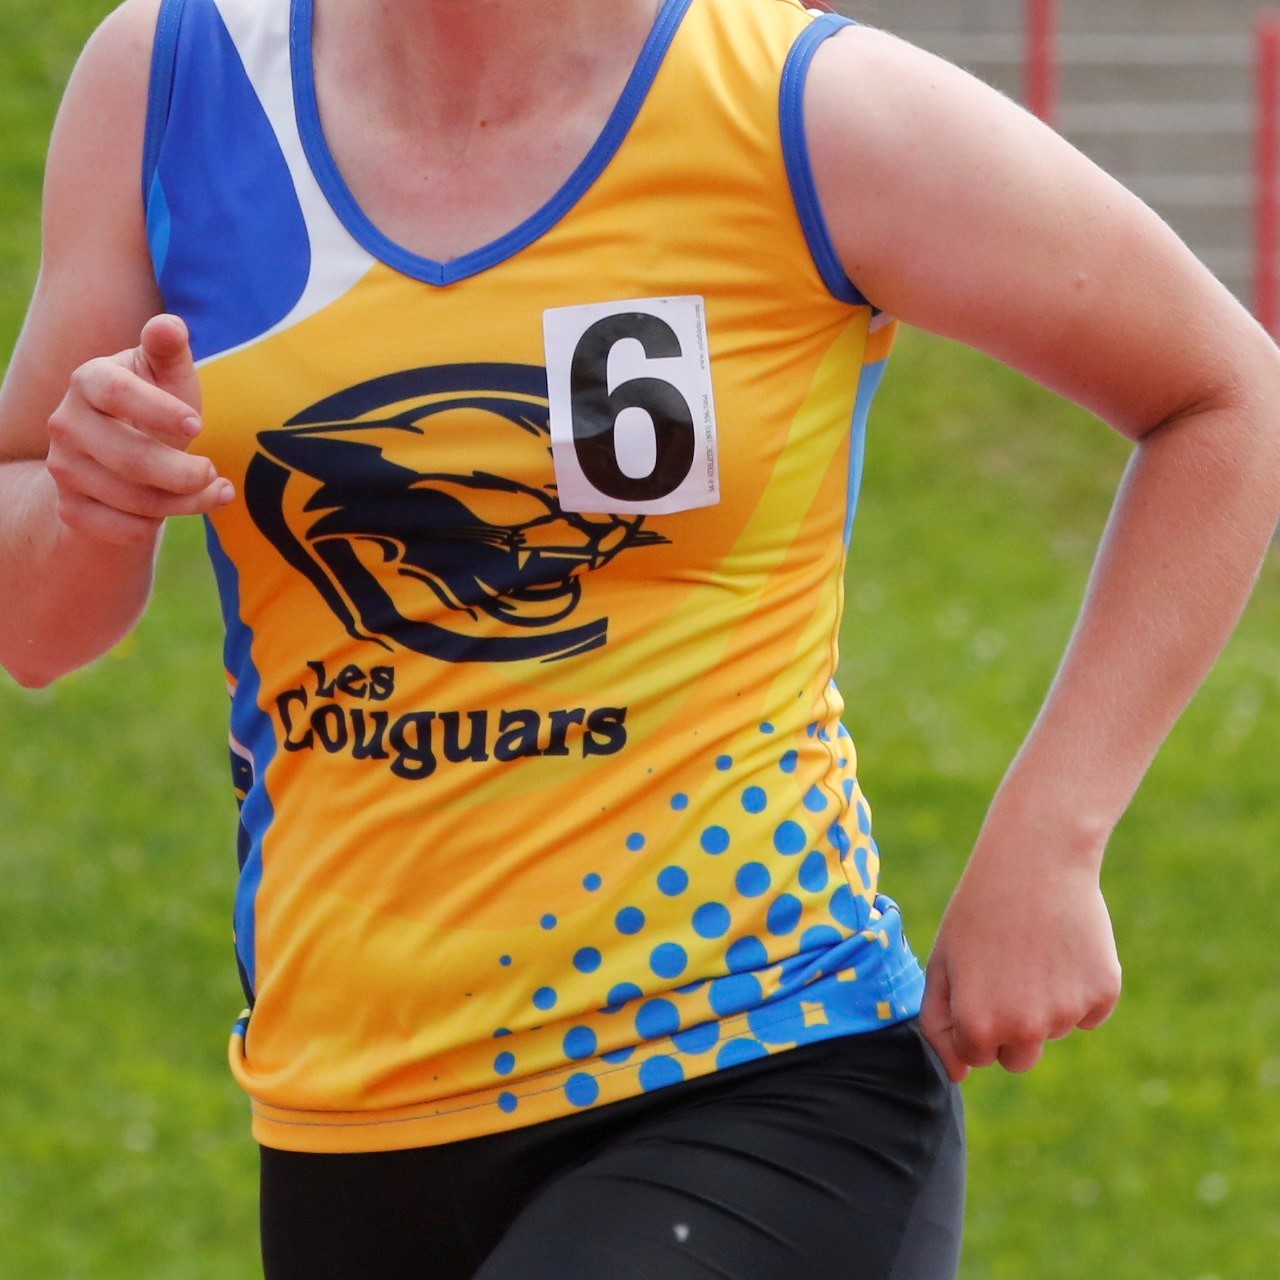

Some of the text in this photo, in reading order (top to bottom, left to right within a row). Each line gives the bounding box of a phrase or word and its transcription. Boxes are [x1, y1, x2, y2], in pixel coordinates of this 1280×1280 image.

[569, 311, 696, 502] 6
[306, 661, 395, 701] Les
[276, 689, 628, 780] Couguars
